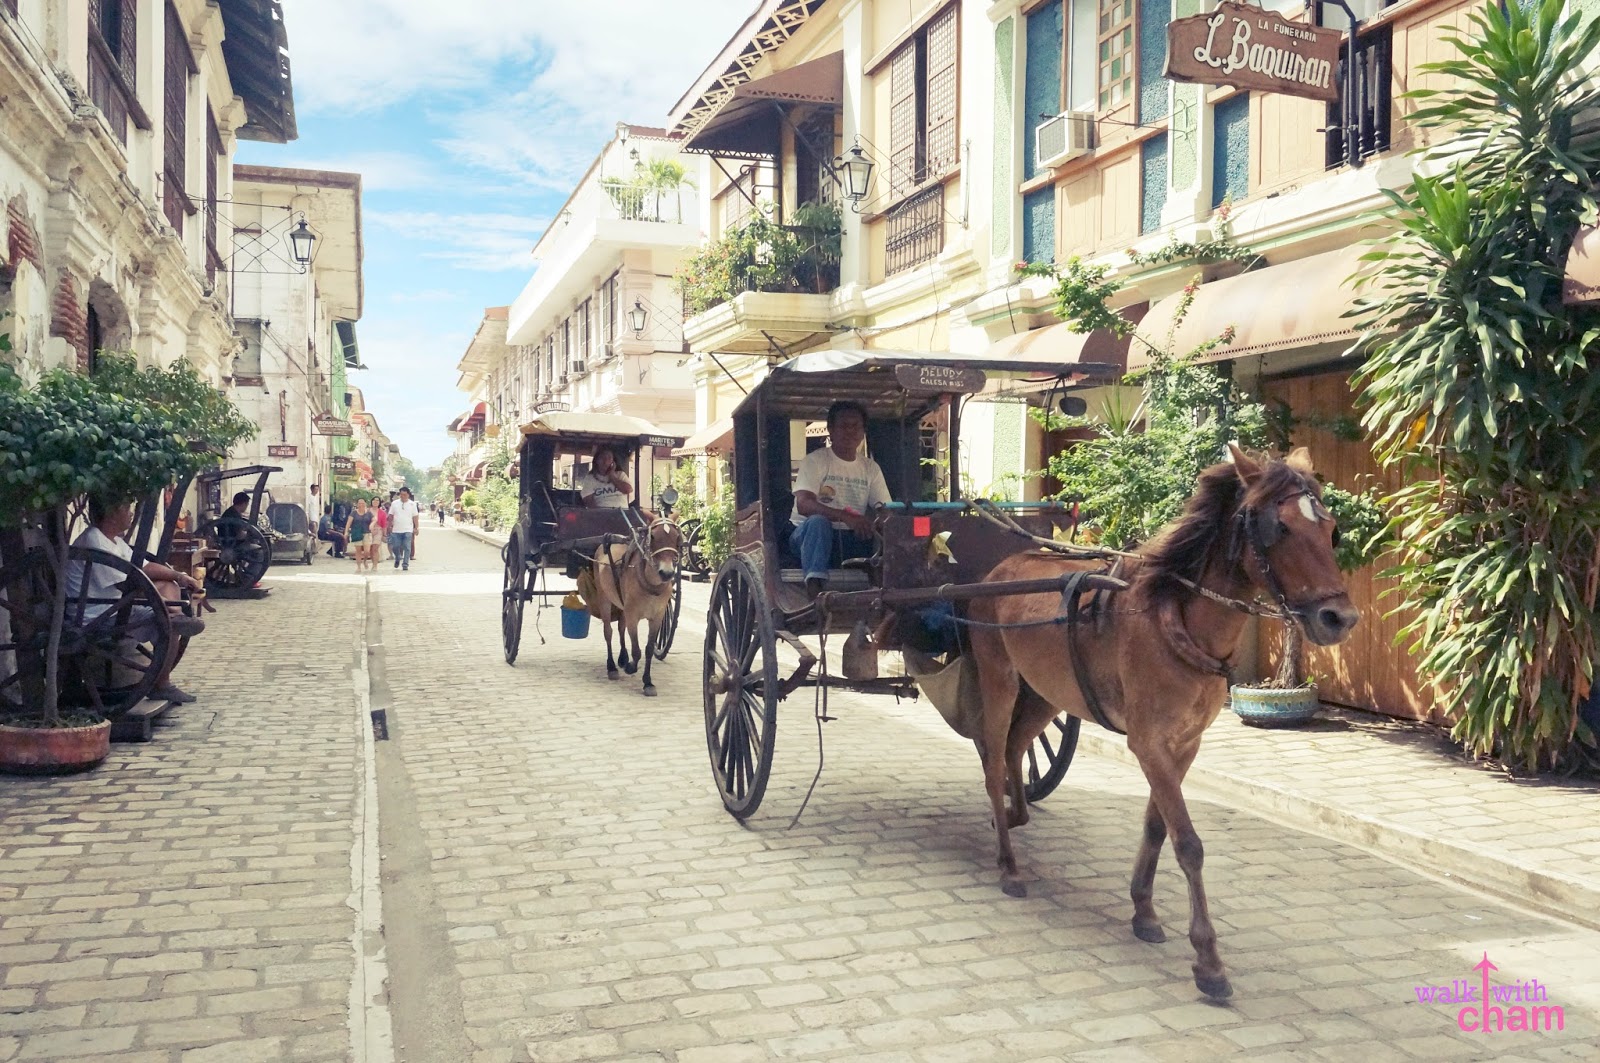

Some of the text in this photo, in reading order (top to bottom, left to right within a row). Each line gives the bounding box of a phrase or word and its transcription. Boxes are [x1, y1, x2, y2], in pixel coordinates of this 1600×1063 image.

[1258, 19, 1317, 43] LA FUNERARIA
[648, 436, 676, 444] MARITES
